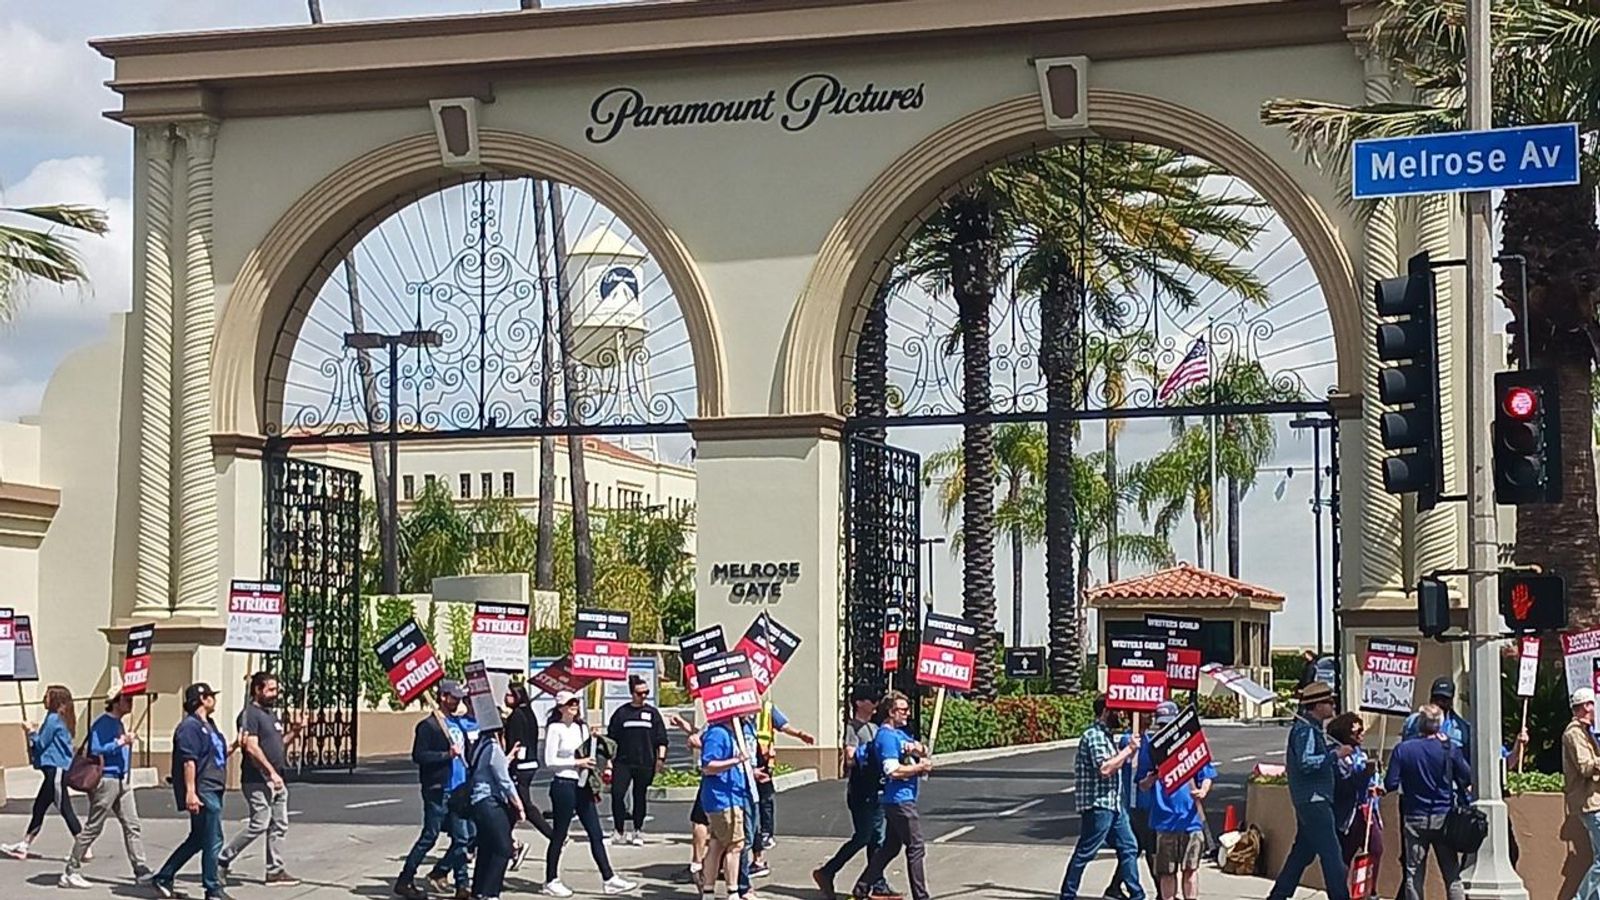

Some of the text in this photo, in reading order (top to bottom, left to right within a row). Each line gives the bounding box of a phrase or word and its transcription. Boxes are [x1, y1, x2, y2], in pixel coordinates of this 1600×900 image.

[585, 74, 925, 143] Paramount Pictures
[1371, 140, 1561, 181] Melrose Av
[713, 562, 800, 579] MELROSE
[732, 582, 782, 598] GATE
[476, 618, 525, 634] STRIKE!
[573, 654, 626, 672] STRIKE!
[920, 659, 970, 681] STRIKE!
[396, 656, 439, 696] STRIKE!
[705, 690, 757, 714] STRIKE!
[1108, 684, 1164, 702] STRIKE!
[1164, 742, 1208, 788] STRIKE!
